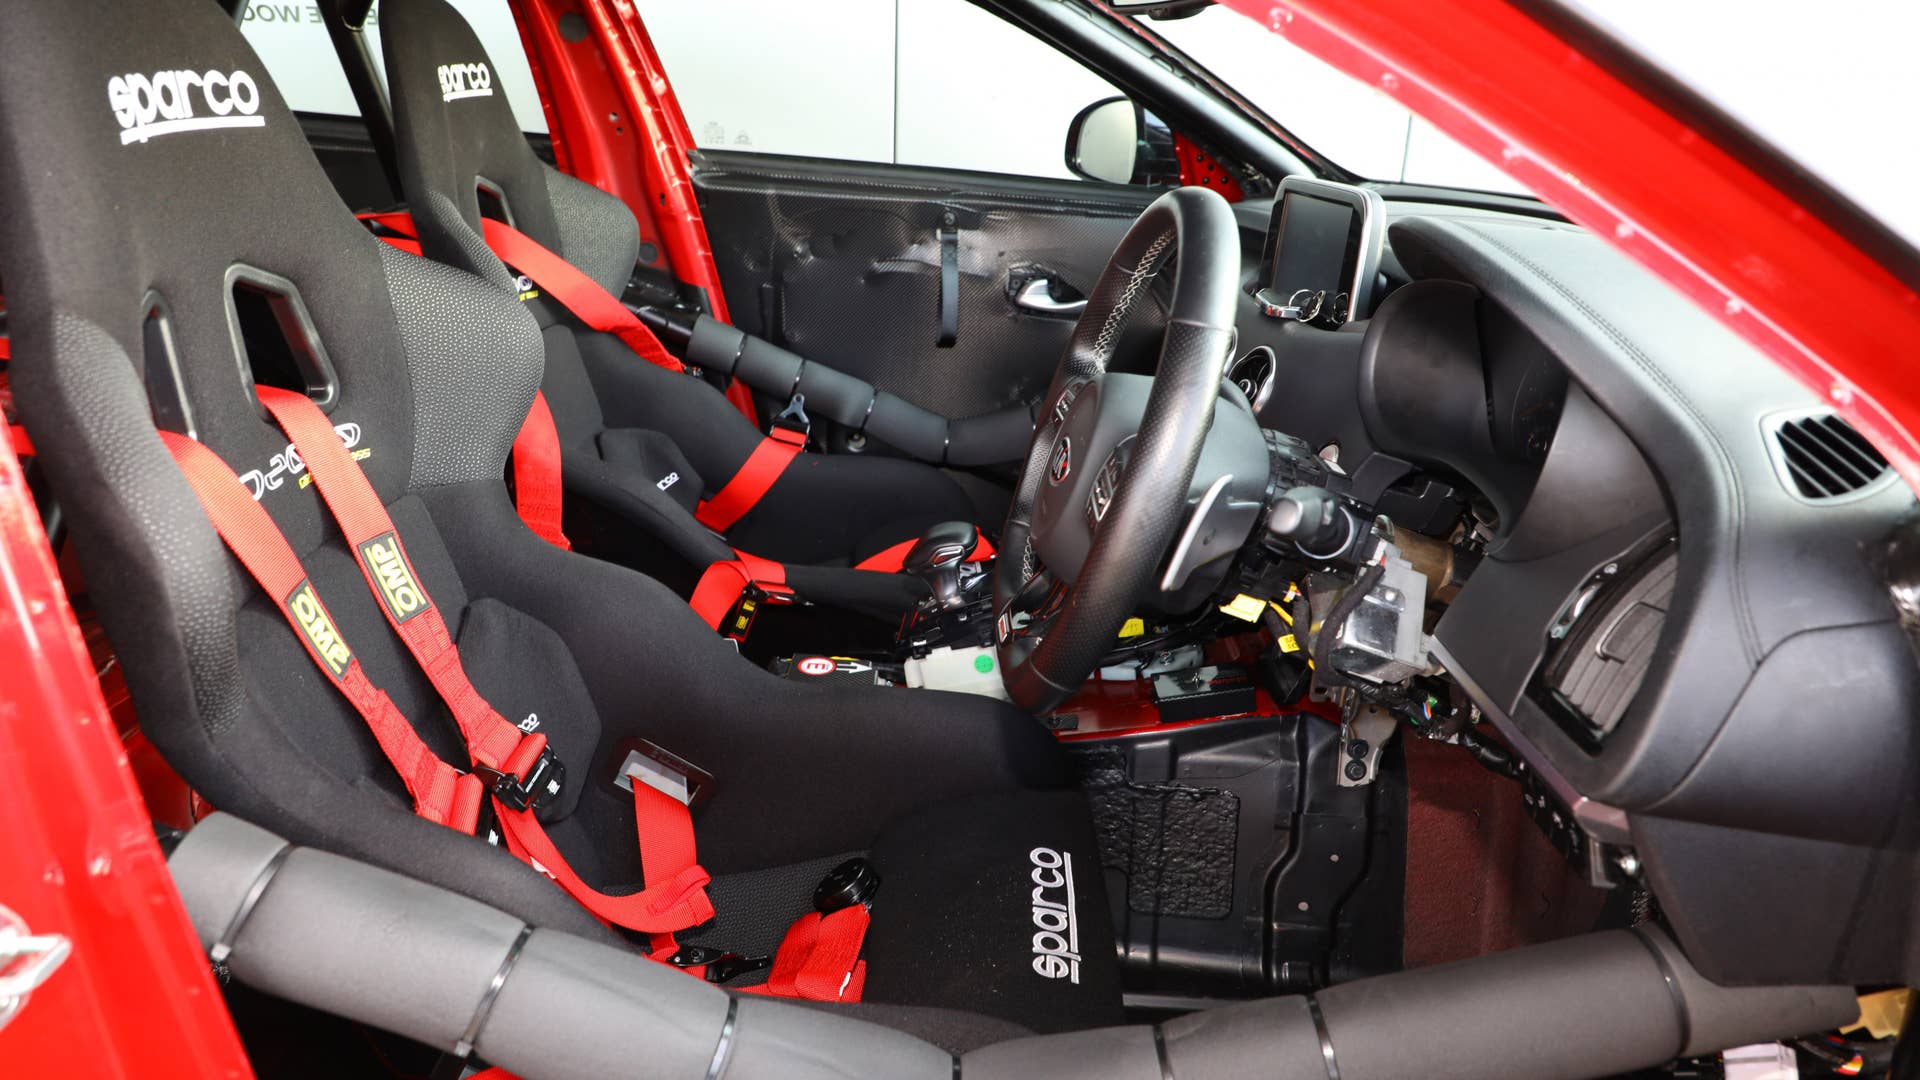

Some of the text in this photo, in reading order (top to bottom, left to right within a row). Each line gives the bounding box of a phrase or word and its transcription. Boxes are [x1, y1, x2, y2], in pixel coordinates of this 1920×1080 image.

[107, 69, 266, 146] sparco
[437, 62, 494, 103] sparco
[368, 540, 422, 614] OMP
[293, 590, 349, 669] OMP
[1029, 846, 1082, 985] sparco
